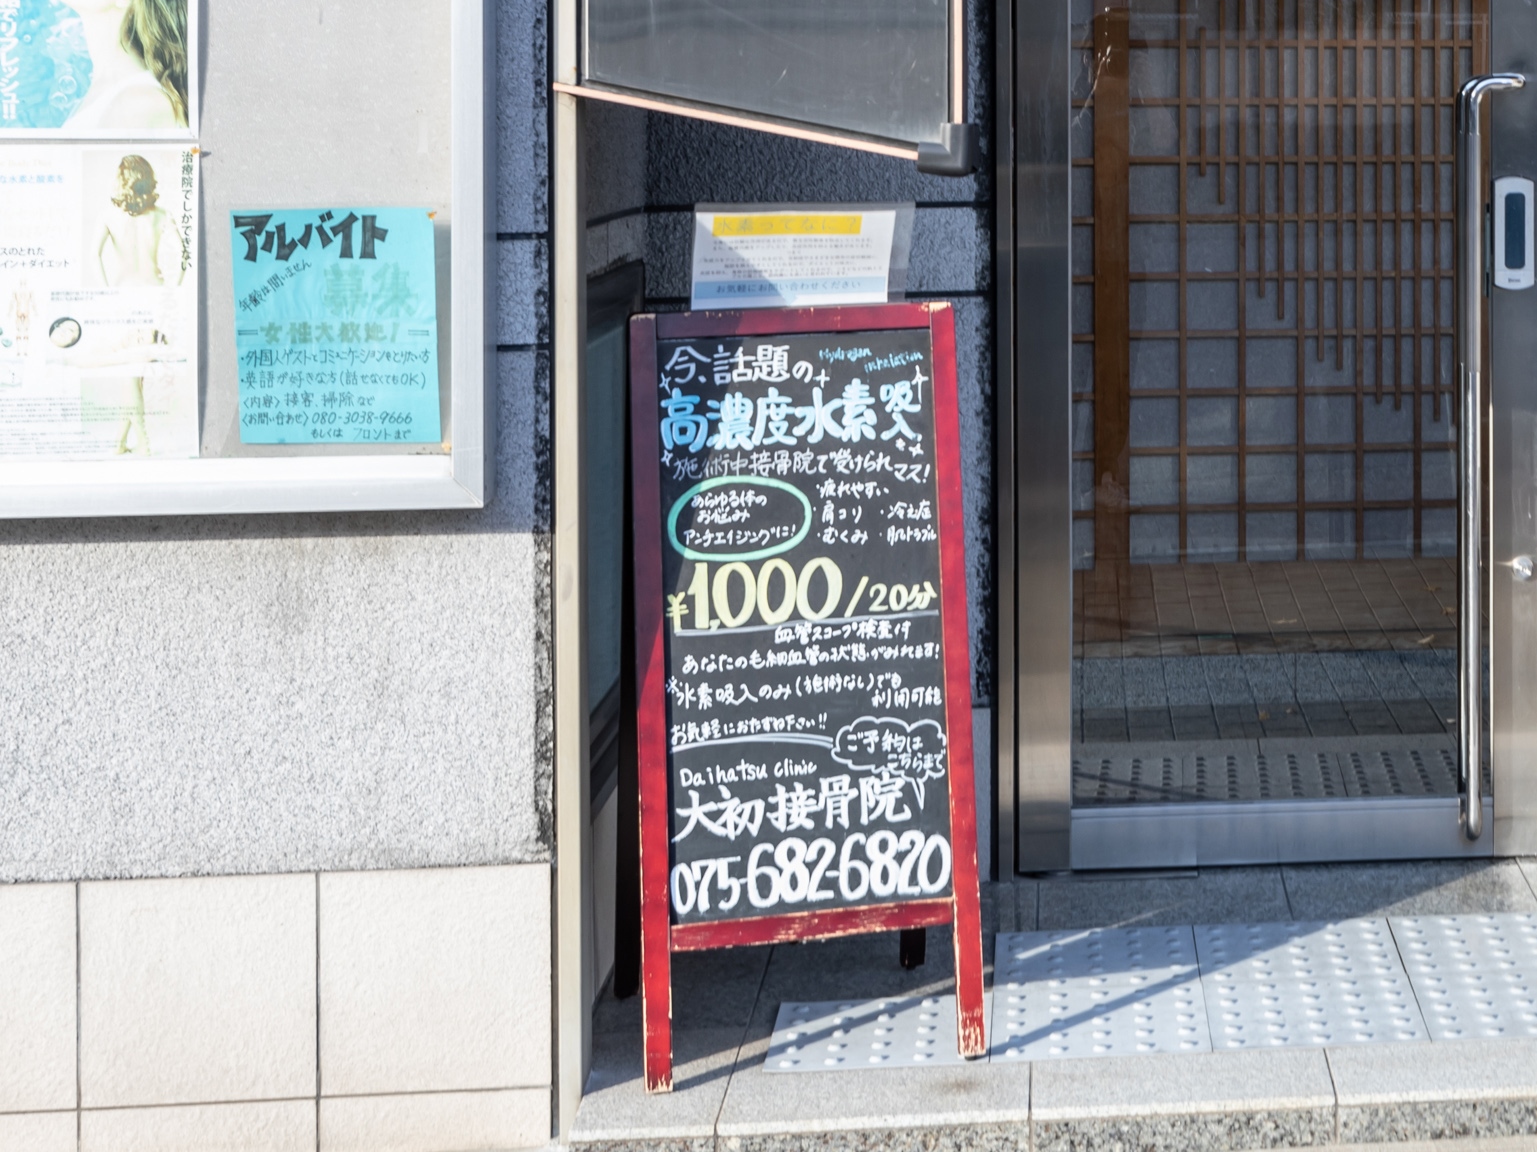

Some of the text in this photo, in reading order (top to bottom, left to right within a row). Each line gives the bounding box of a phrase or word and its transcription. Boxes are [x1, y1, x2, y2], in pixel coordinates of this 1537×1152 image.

[233, 209, 389, 263] アルバイト
[323, 262, 418, 317] 募集
[680, 759, 768, 788] Daihatsu
[671, 829, 952, 915] 075-682-6820
